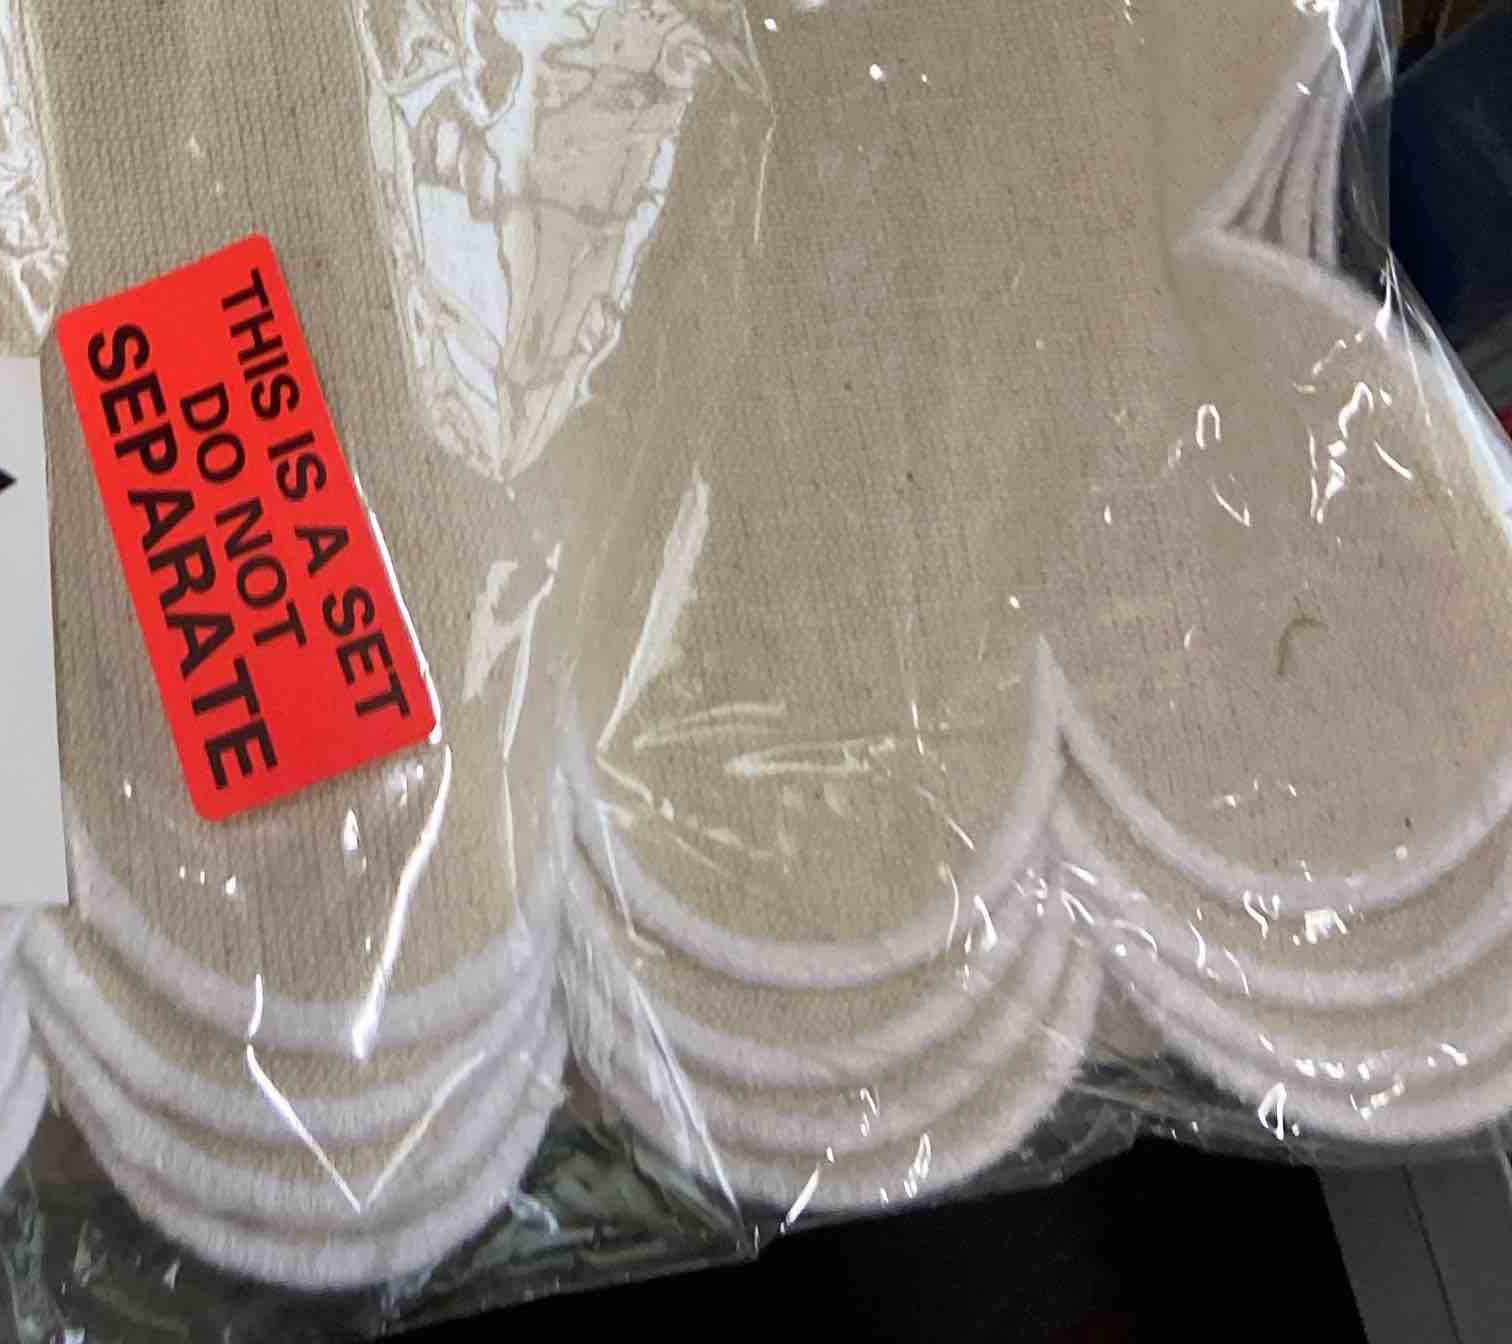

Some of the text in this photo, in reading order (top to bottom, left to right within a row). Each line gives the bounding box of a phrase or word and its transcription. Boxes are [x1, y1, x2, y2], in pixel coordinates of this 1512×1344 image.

[88, 322, 278, 790] SEPARATE
[180, 381, 307, 647] DO NOT
[221, 269, 411, 720] THIS IS A SET
